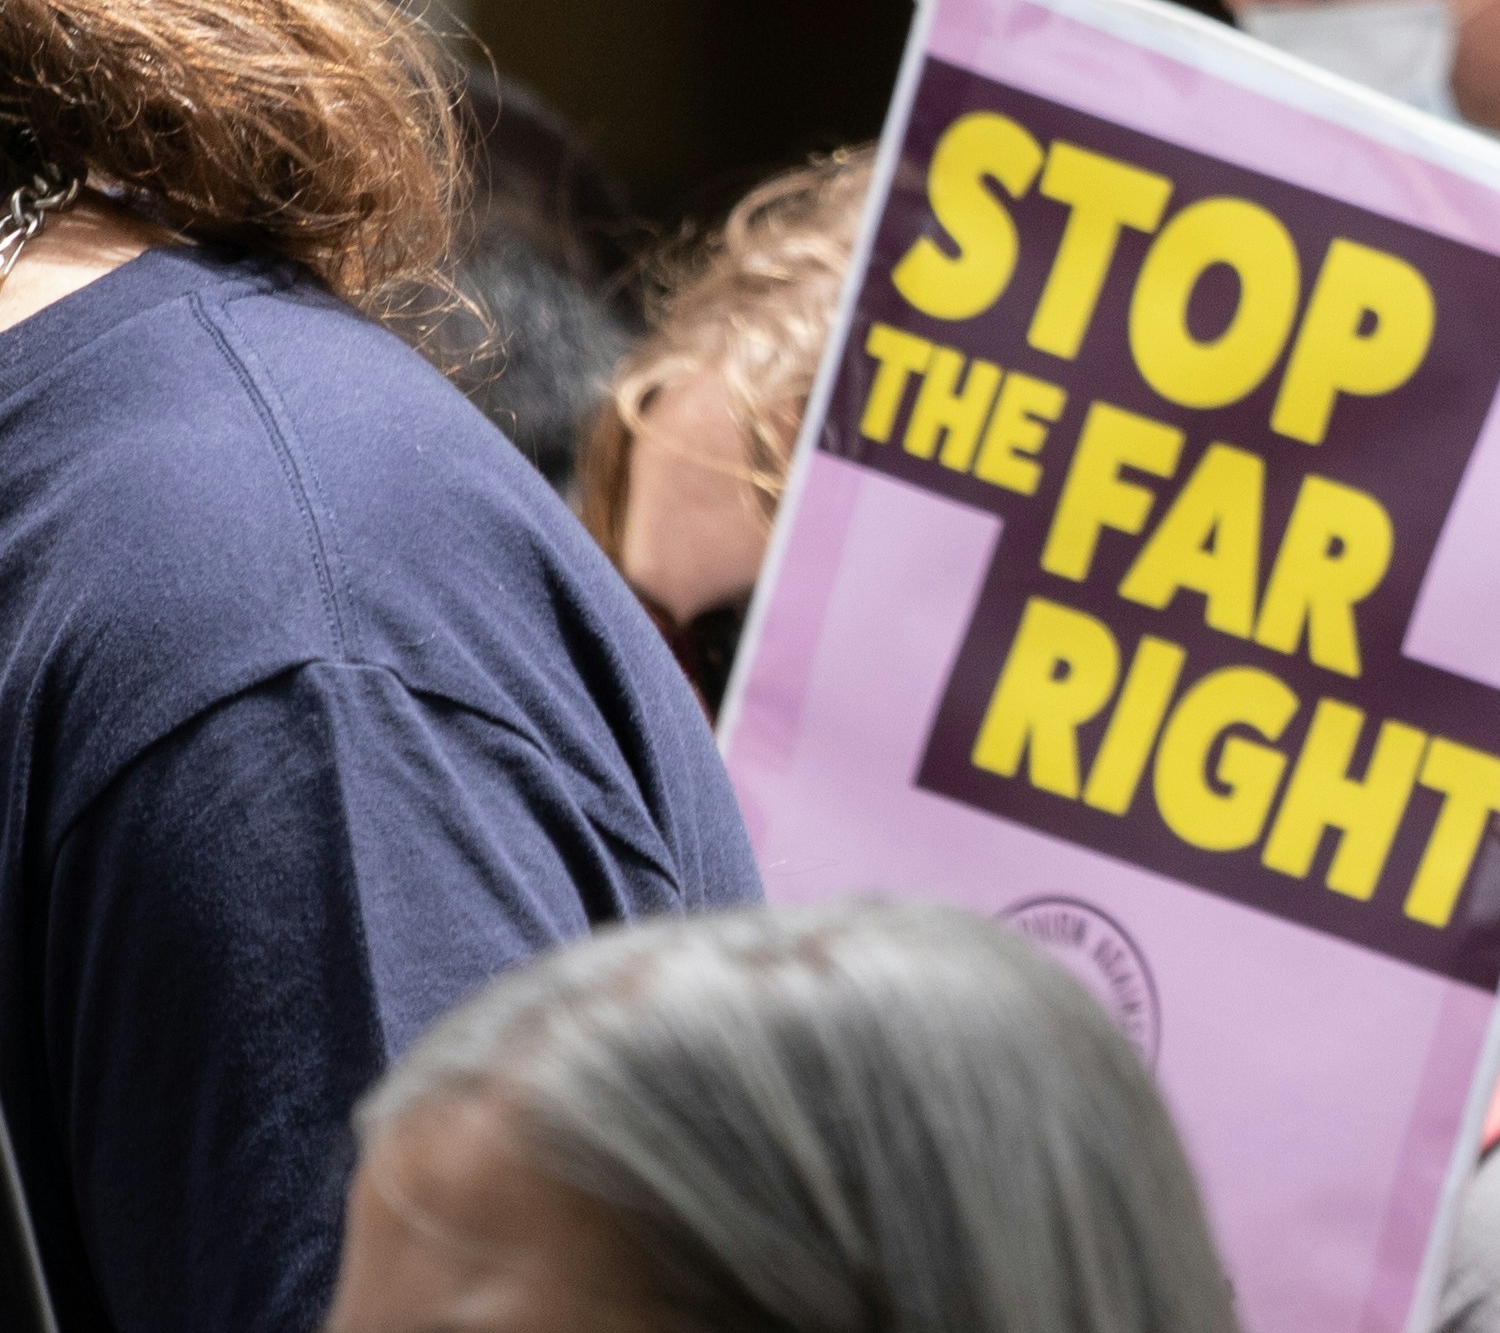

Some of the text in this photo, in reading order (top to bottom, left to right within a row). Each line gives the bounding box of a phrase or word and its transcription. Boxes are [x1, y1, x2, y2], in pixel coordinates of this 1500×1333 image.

[893, 114, 1433, 443] STOP
[862, 326, 1392, 676] THE FAR
